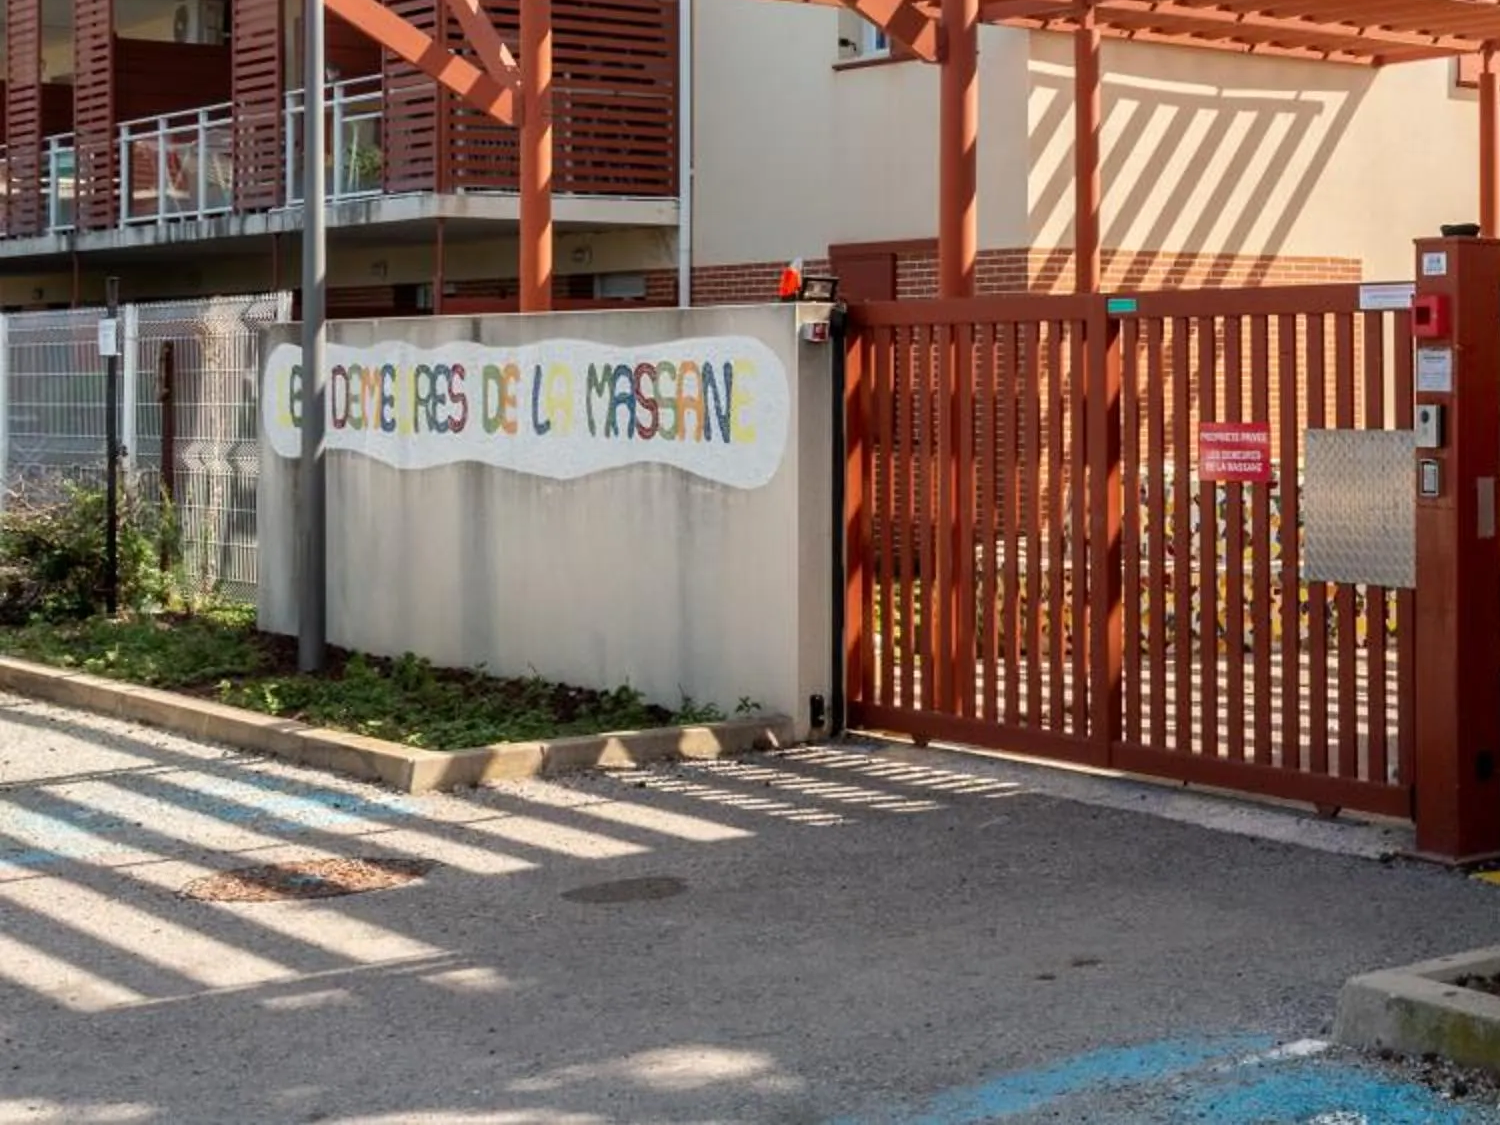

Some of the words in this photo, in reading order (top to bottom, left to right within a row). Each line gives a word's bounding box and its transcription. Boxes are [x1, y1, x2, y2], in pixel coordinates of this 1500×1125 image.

[332, 362, 468, 435] DEMEURES
[482, 362, 520, 435] DE
[531, 362, 573, 435] LA
[586, 359, 757, 444] MASSANE
